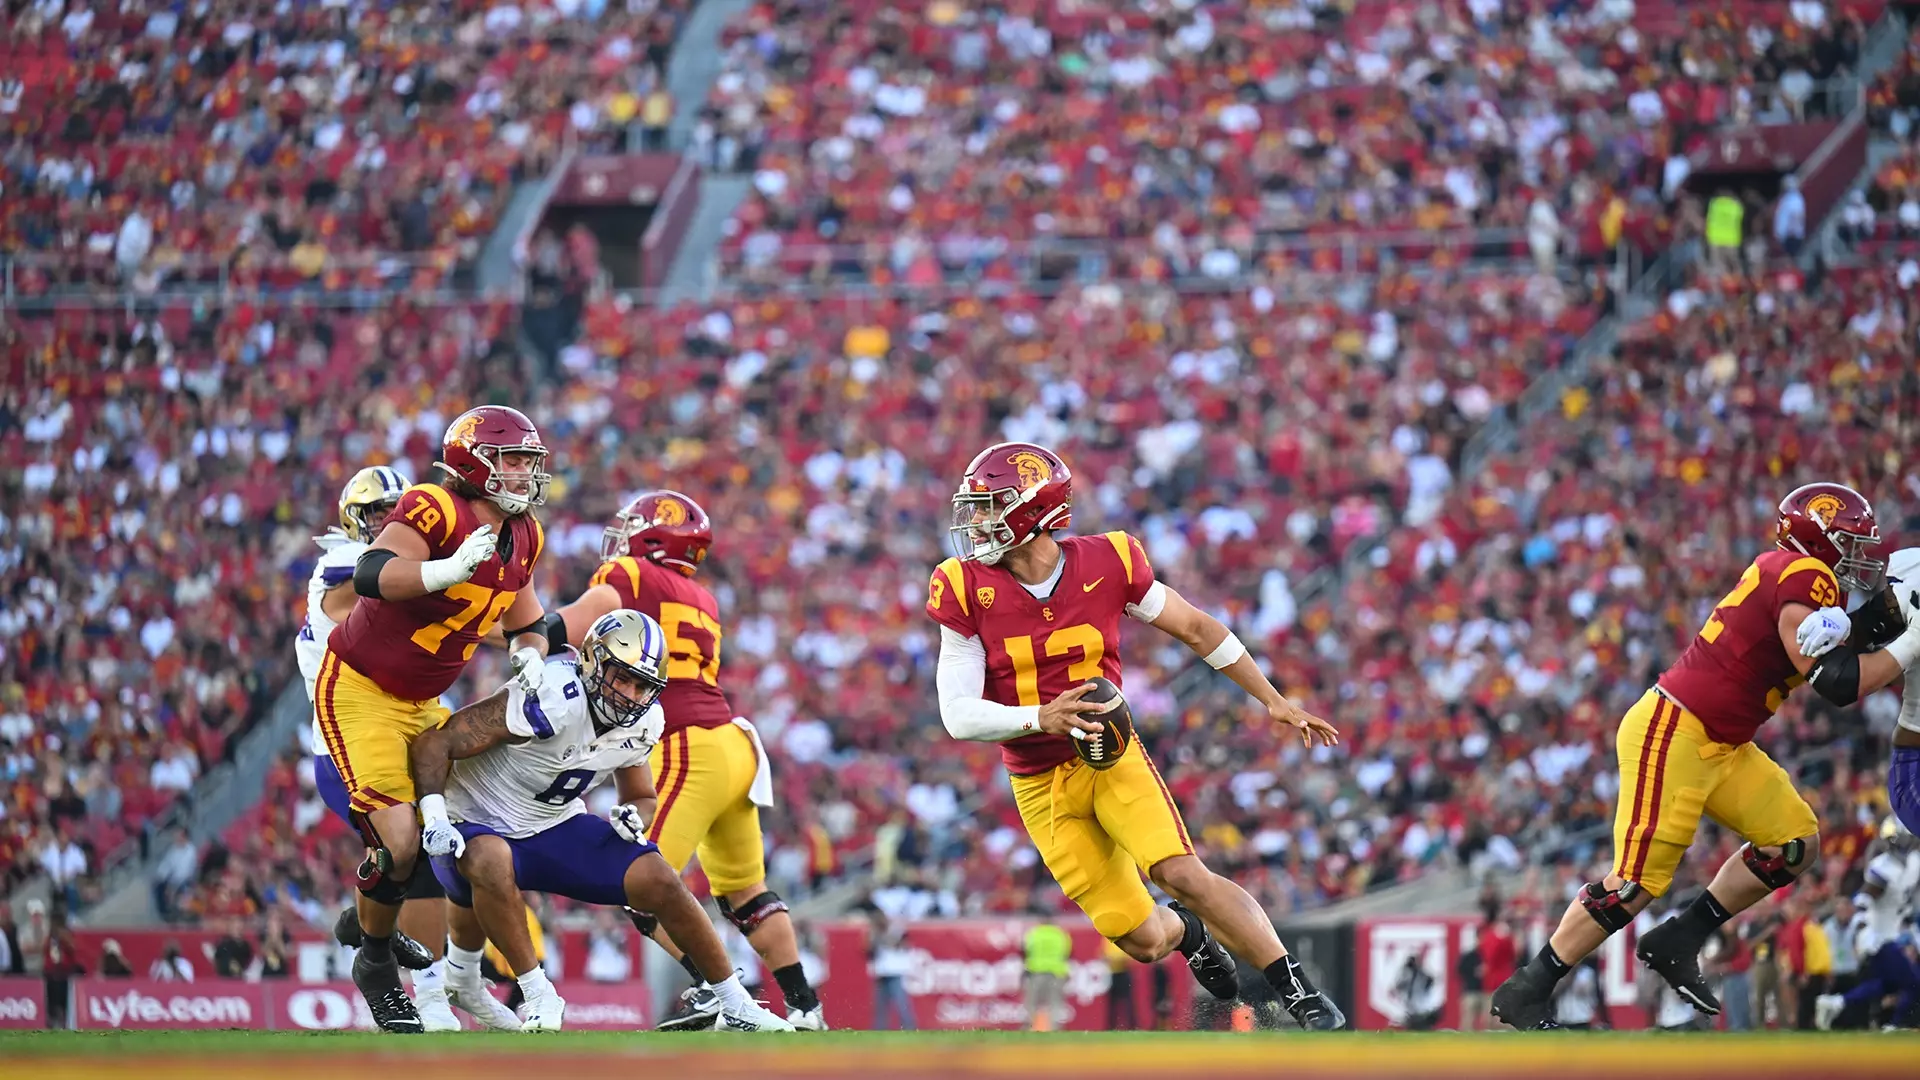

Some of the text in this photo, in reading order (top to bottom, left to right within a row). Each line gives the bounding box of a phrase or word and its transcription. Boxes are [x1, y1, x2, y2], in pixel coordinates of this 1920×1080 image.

[404, 495, 441, 534] 79
[595, 614, 624, 638] W
[1003, 623, 1104, 706] 13
[533, 768, 597, 806] 8
